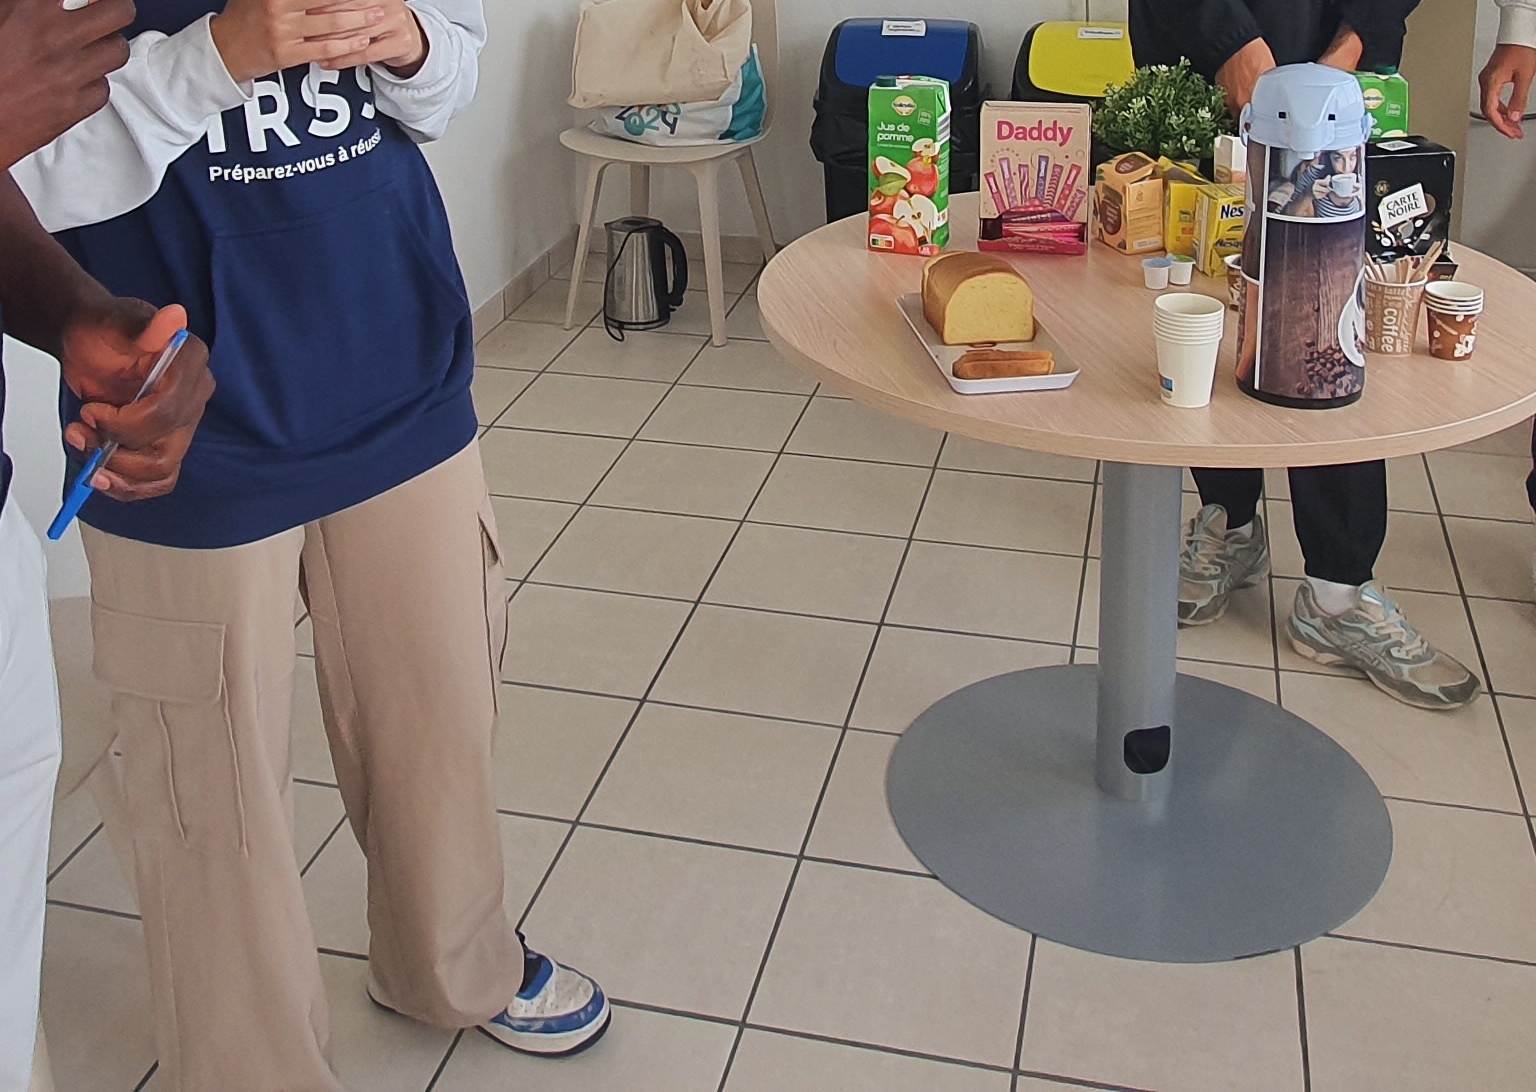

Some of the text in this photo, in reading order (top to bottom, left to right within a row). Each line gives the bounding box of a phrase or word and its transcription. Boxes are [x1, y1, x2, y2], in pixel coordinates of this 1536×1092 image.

[877, 121, 910, 132] Jus de
[997, 119, 1073, 147] Daddy
[877, 133, 914, 142] pomme
[208, 152, 335, 184] Préparez-vous
[338, 145, 349, 162] à
[1386, 192, 1418, 211] CARTE
[1388, 201, 1421, 220] NOIRE
[1381, 308, 1399, 353] coffee
